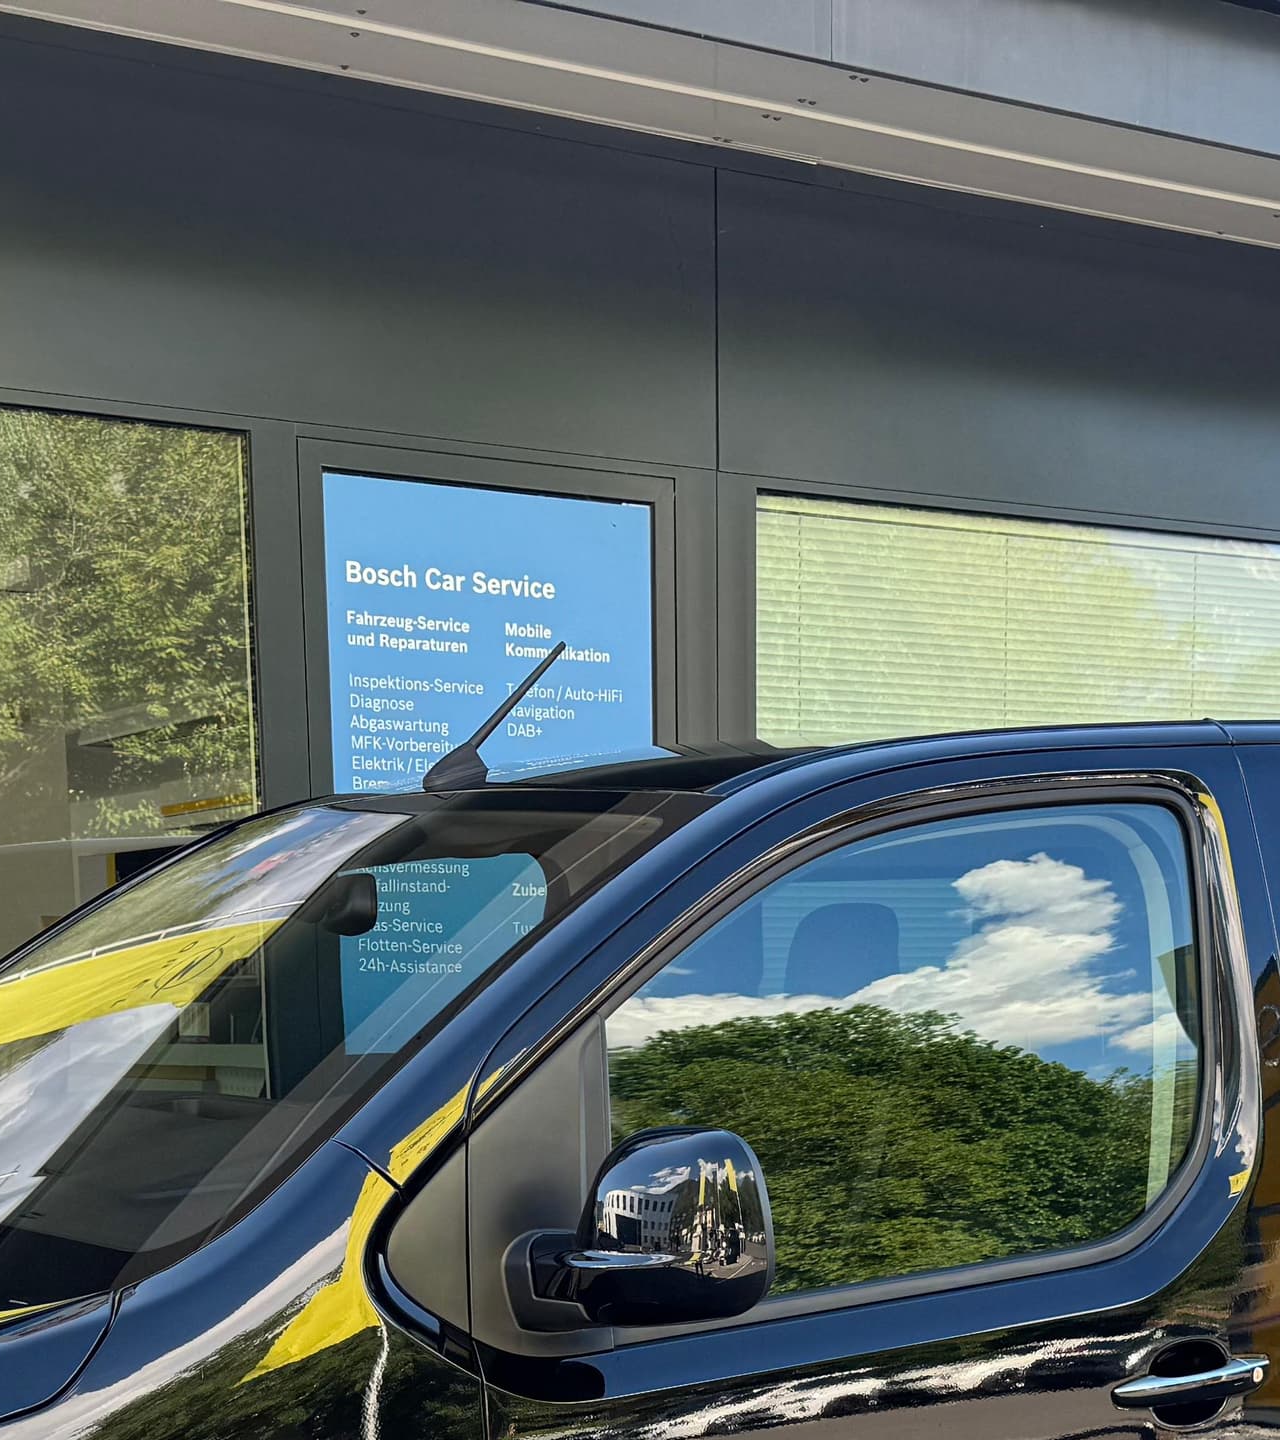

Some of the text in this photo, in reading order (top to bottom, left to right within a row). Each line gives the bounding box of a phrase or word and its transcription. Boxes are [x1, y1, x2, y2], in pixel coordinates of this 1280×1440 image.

[345, 559, 556, 600] Bosch Car Service
[346, 609, 471, 633] Fahrzeug-Service
[504, 621, 552, 639] Mobile
[347, 632, 469, 654] und Reparaturen
[505, 642, 611, 663] Kommnikation
[348, 671, 485, 695] Inspektions-Service
[505, 682, 555, 699] Tefon
[564, 686, 623, 703] Auto-HiFi
[349, 693, 415, 712] Diagnose
[350, 714, 449, 737] Abgaswartung
[507, 722, 543, 738] DAB+
[351, 755, 405, 772] Elektrik
[406, 757, 413, 774] /
[376, 878, 451, 893] fallinstand-
[512, 882, 547, 897] Zube
[378, 902, 411, 915] zung
[370, 918, 443, 934] as-Service
[358, 938, 463, 955] Flotten-Service
[358, 957, 463, 974] 24h-Assistance
